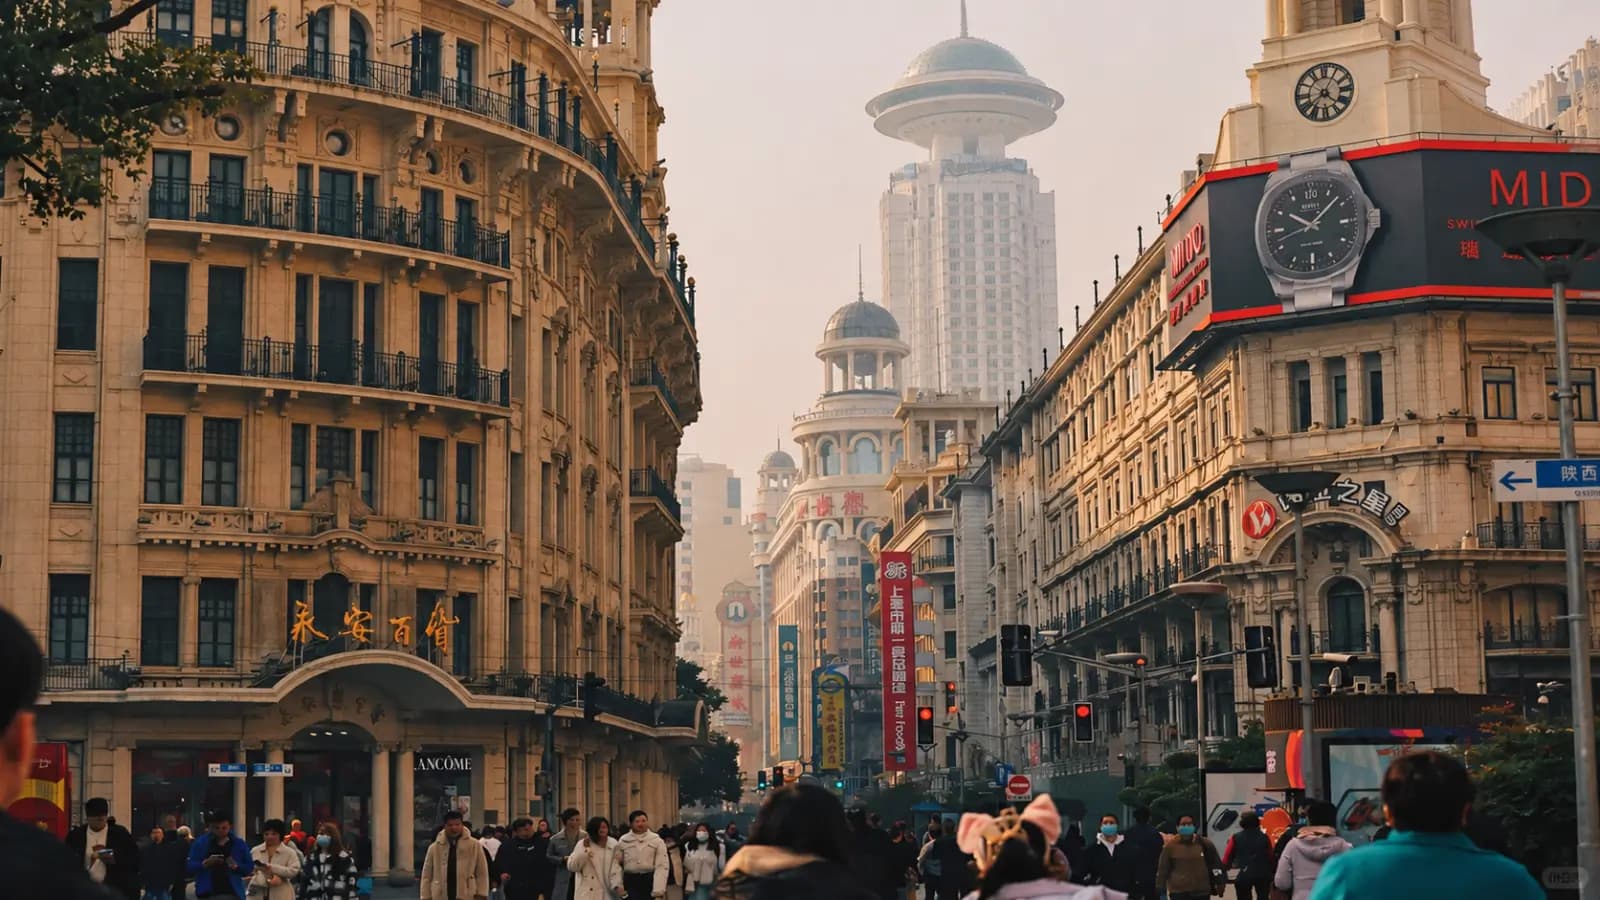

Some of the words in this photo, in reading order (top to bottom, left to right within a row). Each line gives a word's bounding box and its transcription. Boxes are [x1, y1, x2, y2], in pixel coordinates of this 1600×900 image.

[1171, 223, 1203, 278] MIDO
[1561, 465, 1598, 482] 陕西
[414, 755, 472, 770] ANCÔME
